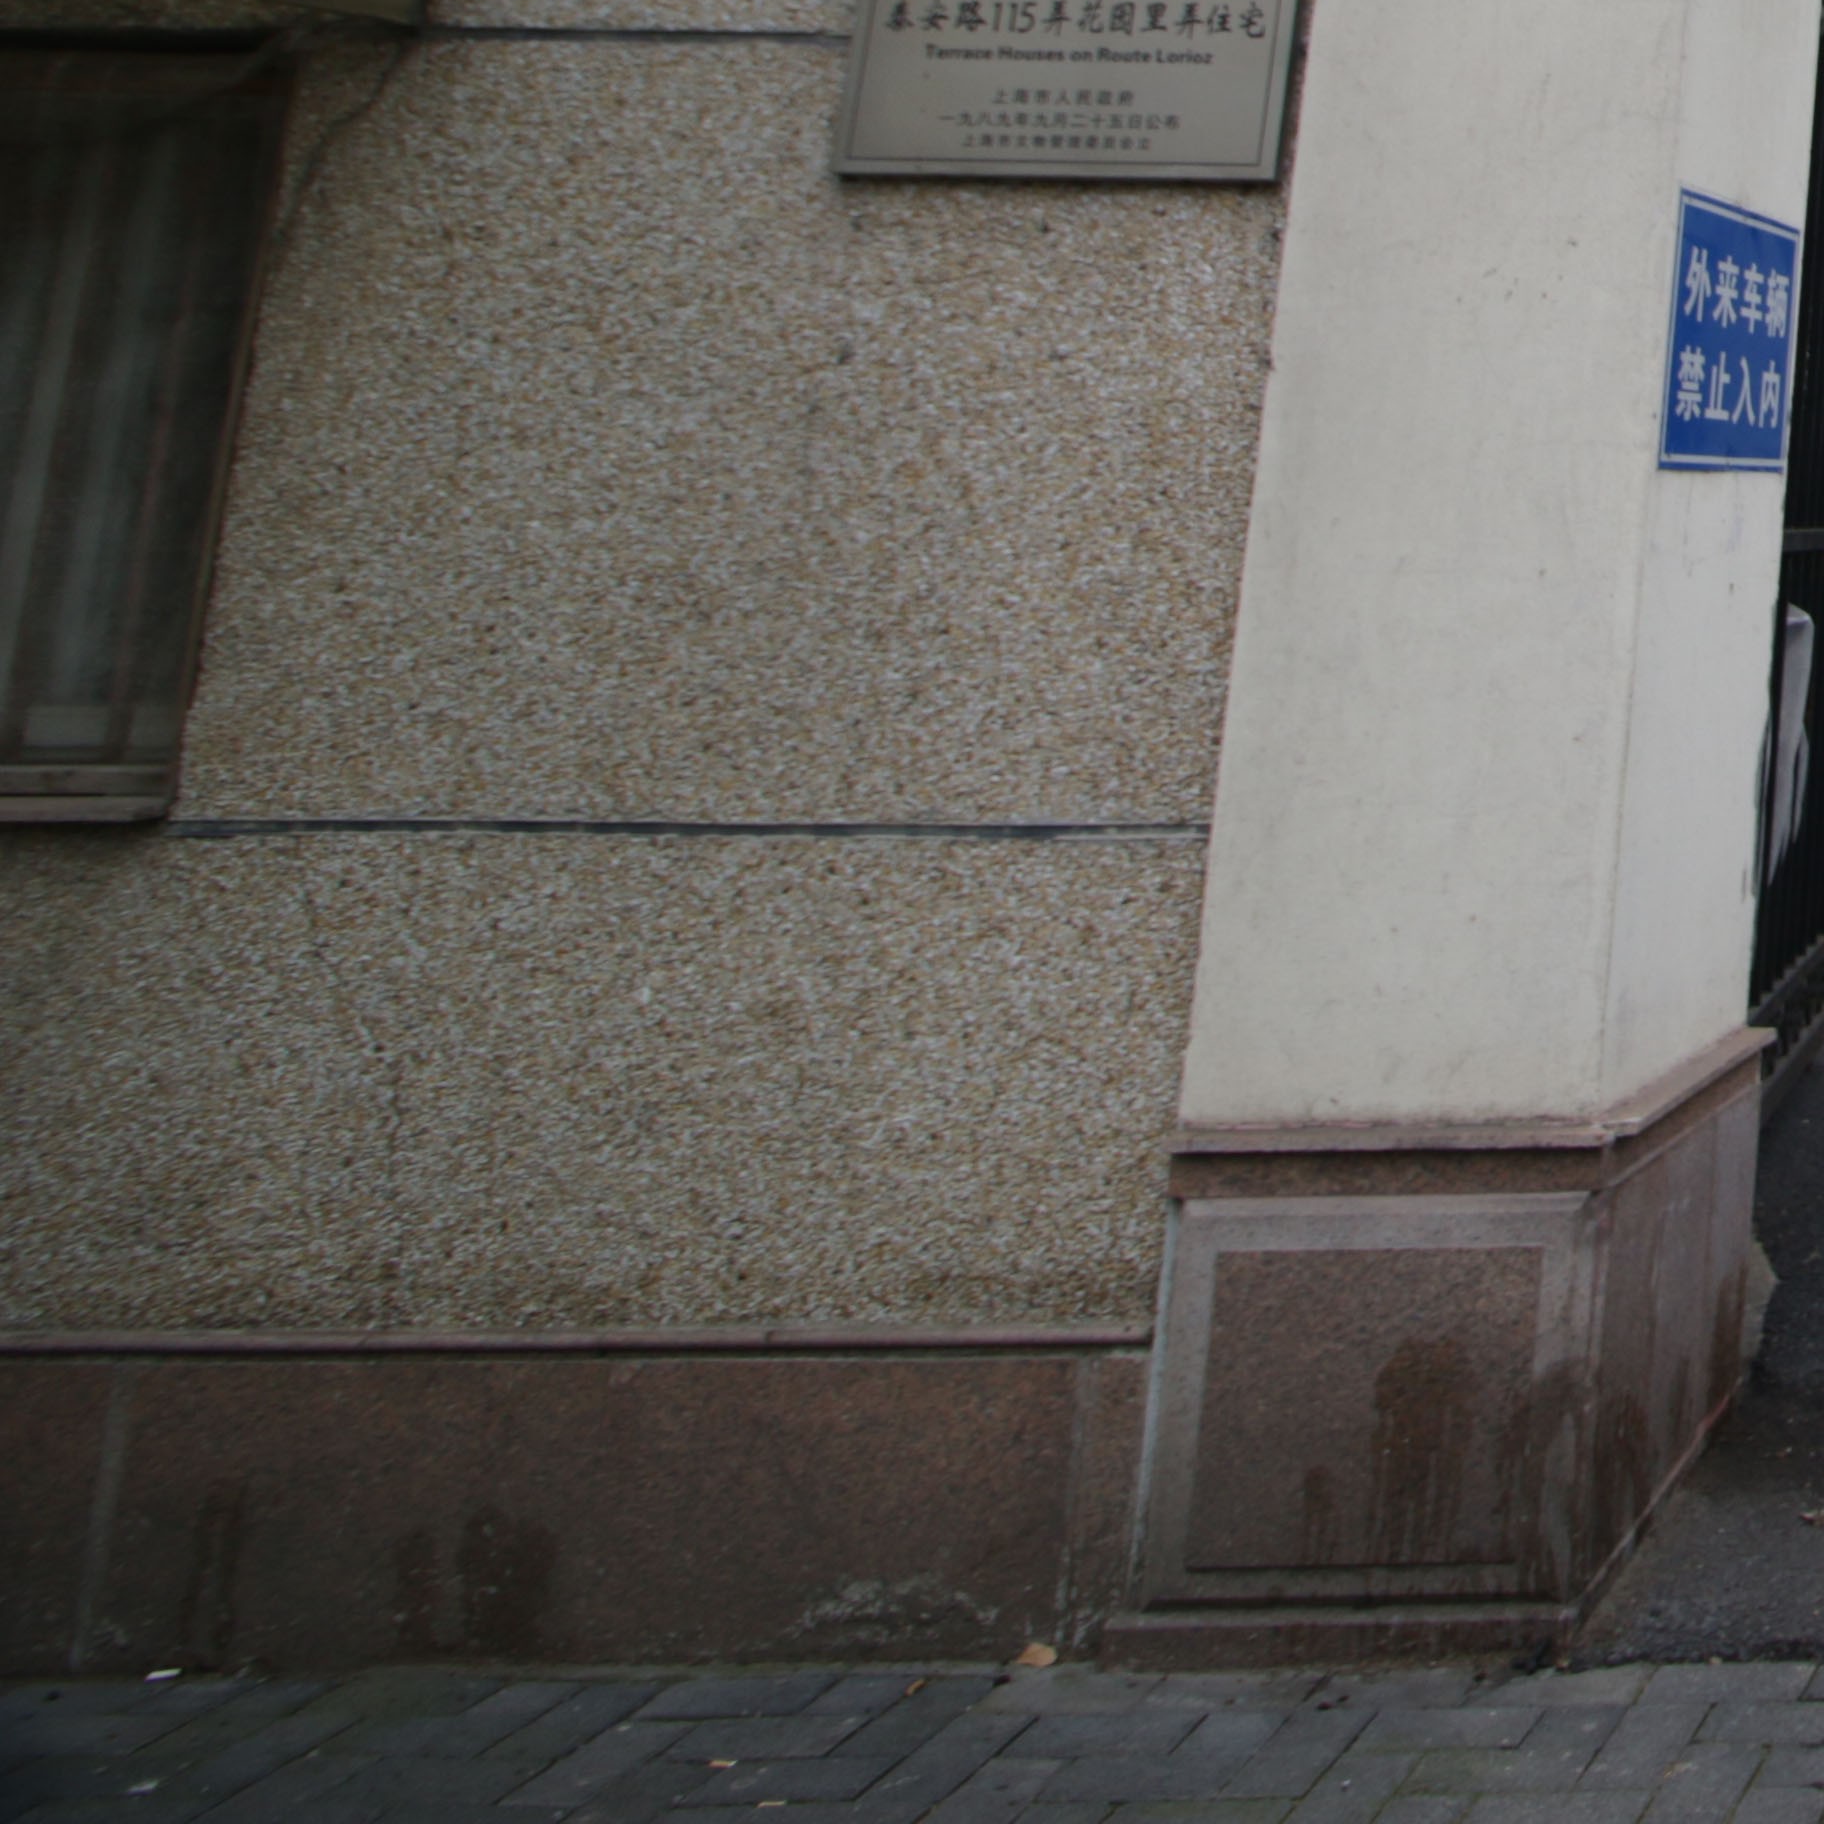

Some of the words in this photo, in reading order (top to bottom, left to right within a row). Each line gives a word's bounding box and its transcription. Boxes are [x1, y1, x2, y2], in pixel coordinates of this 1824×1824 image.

[925, 43, 992, 62] Terrace
[998, 45, 1066, 63] Houses
[1070, 49, 1093, 63] on
[1097, 46, 1152, 65] Route
[1684, 245, 1790, 338] 外来车辆
[1676, 345, 1780, 428] 禁止入内
